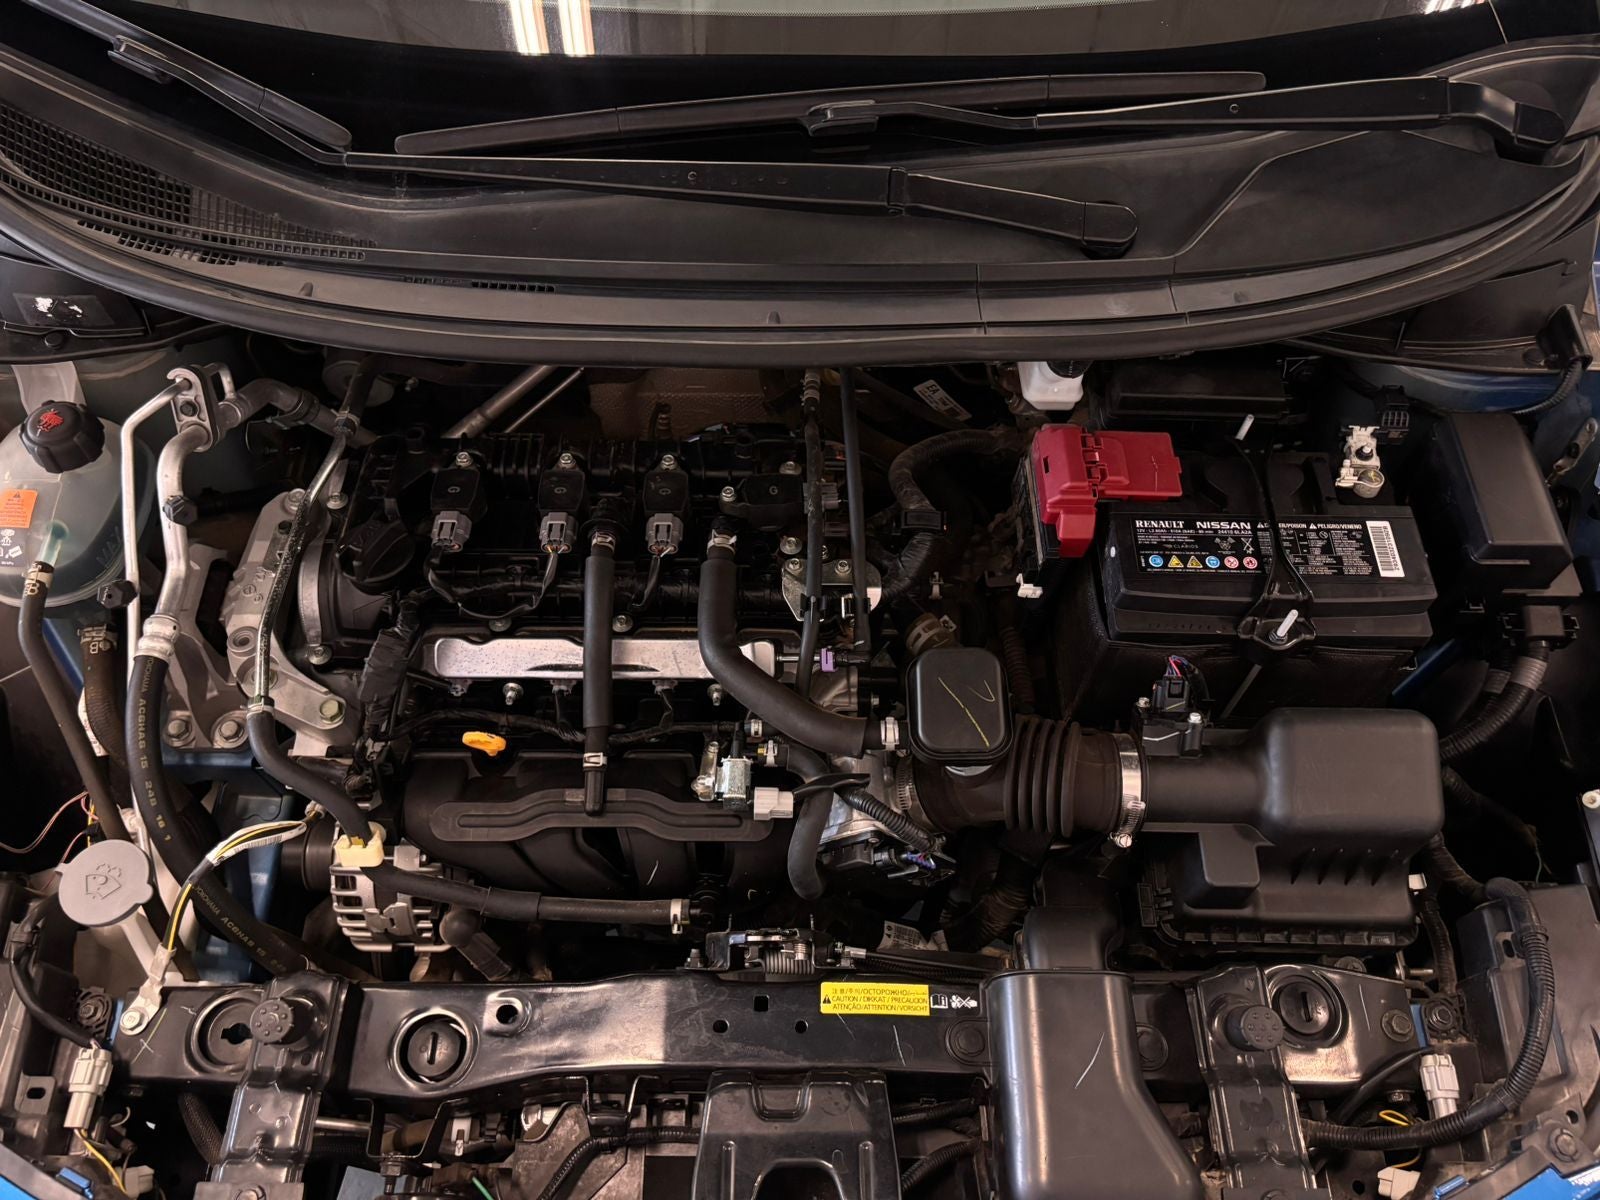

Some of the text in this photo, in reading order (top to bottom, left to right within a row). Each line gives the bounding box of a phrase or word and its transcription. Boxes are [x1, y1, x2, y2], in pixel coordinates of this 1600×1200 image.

[769, 485, 778, 495] G
[1135, 519, 1251, 530] RENAULT NISSAN
